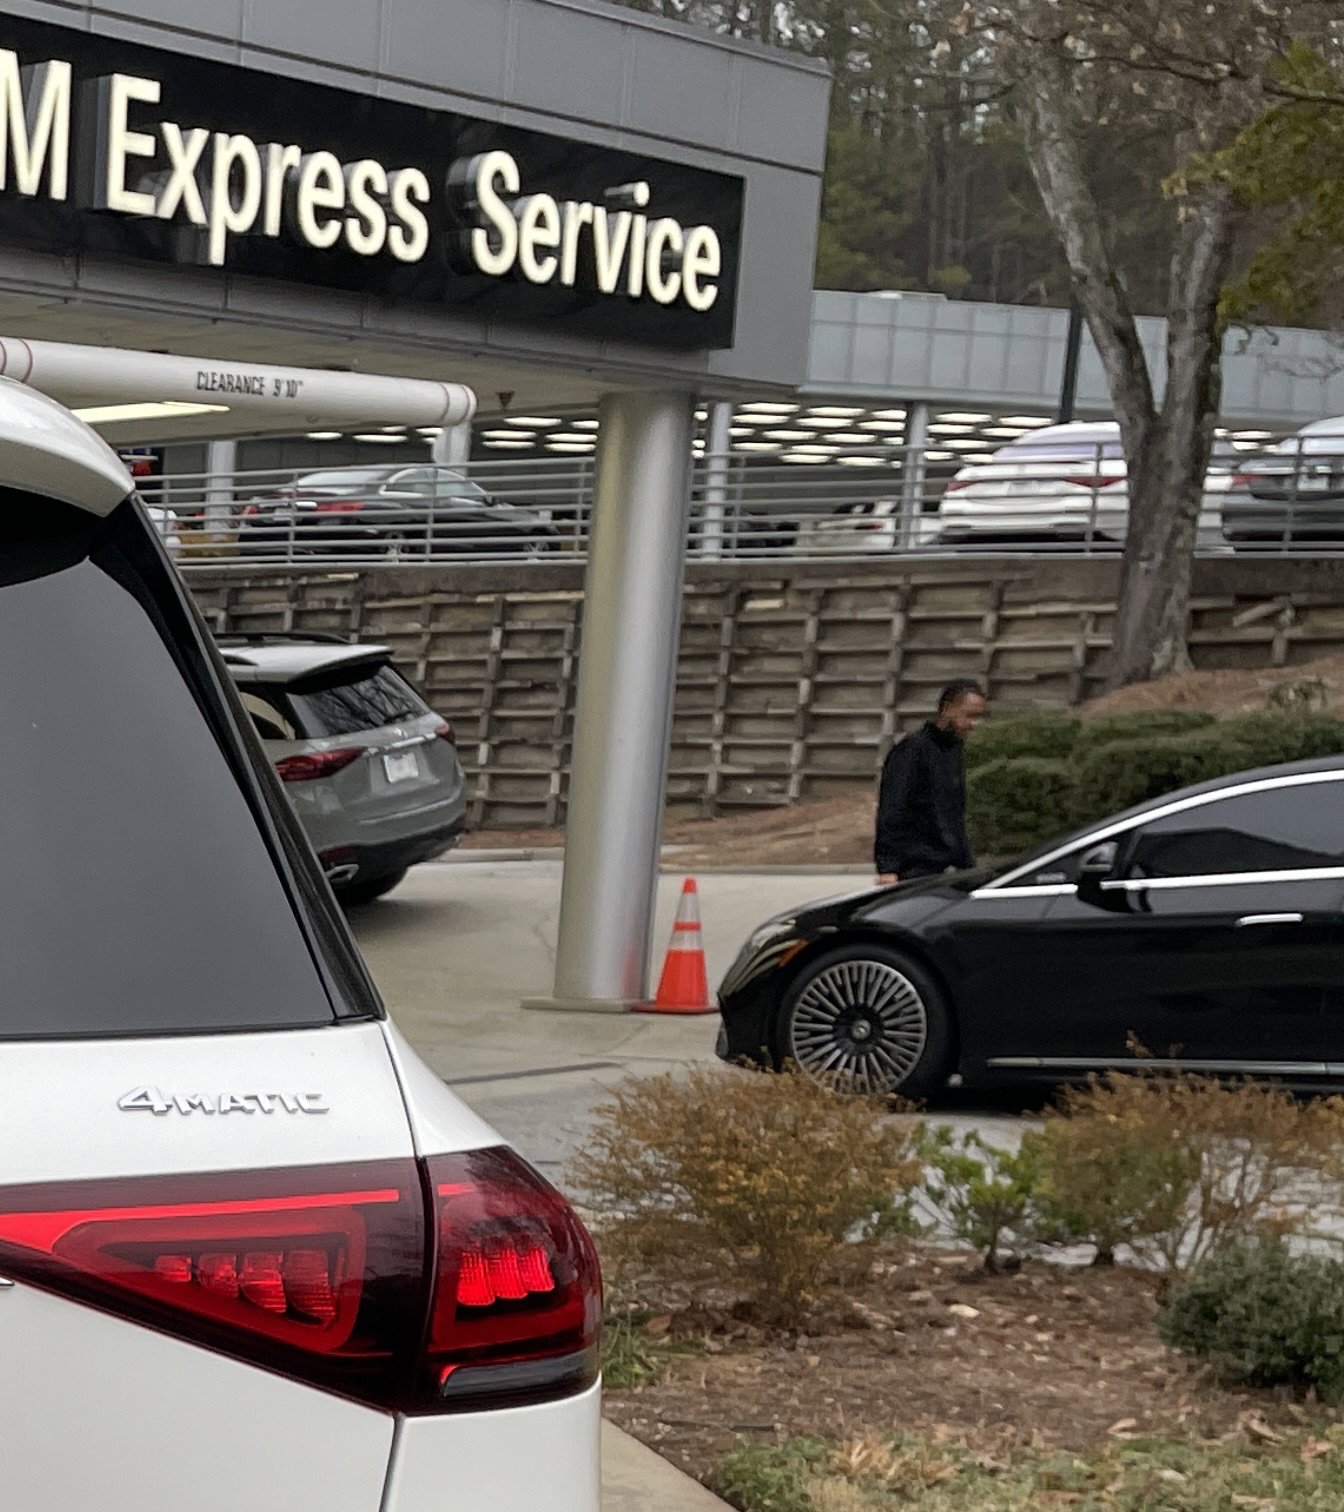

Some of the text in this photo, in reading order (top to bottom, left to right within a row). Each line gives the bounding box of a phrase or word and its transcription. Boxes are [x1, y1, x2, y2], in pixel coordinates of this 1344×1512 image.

[105, 72, 432, 267] Express
[470, 149, 723, 313] Service
[196, 370, 265, 396] CLEARANCE
[116, 1084, 331, 1117] 4MATIC
